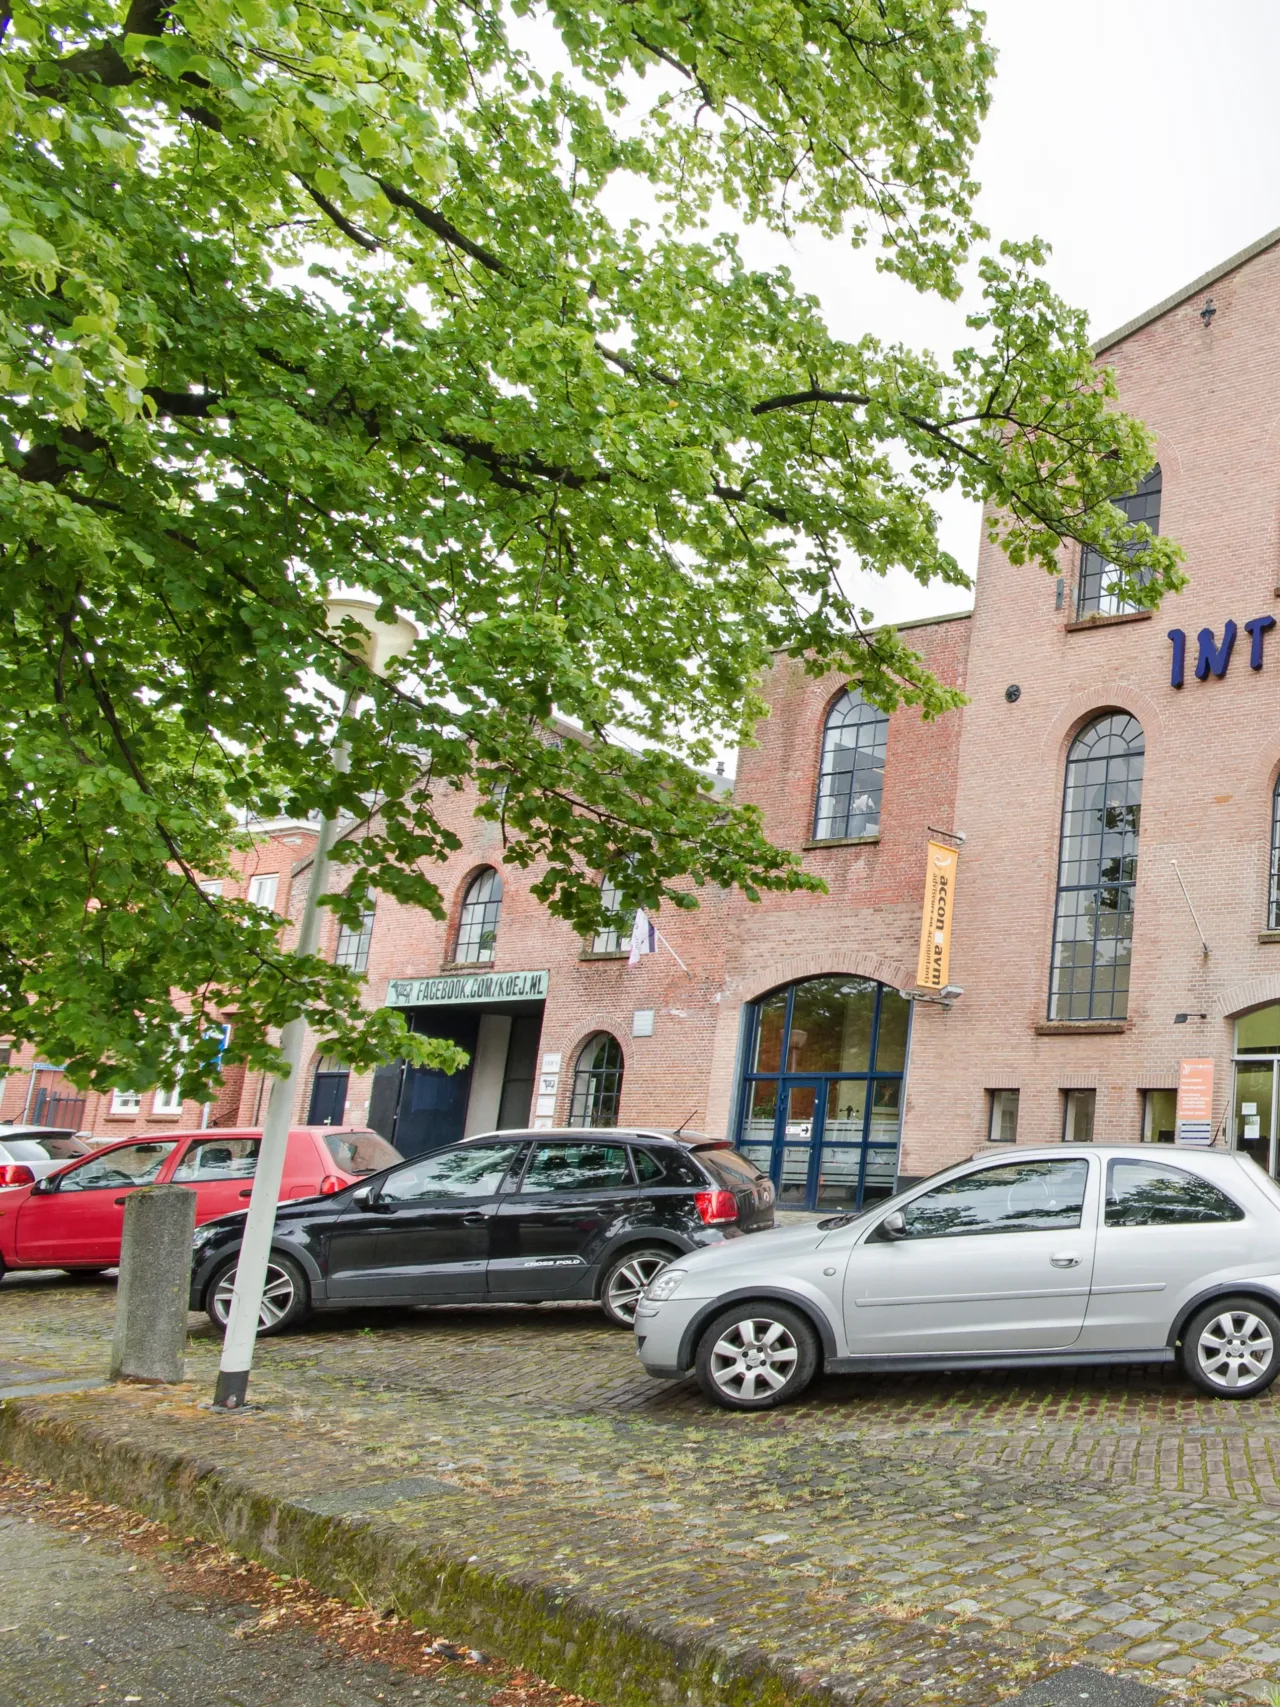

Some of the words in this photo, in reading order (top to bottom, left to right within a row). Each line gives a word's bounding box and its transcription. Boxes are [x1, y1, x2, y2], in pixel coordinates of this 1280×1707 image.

[935, 875, 948, 930] accon
[924, 929, 933, 984] accountants
[932, 945, 943, 986] avm
[416, 974, 544, 1001] FACEBOOK.COM/KOEJ.NL
